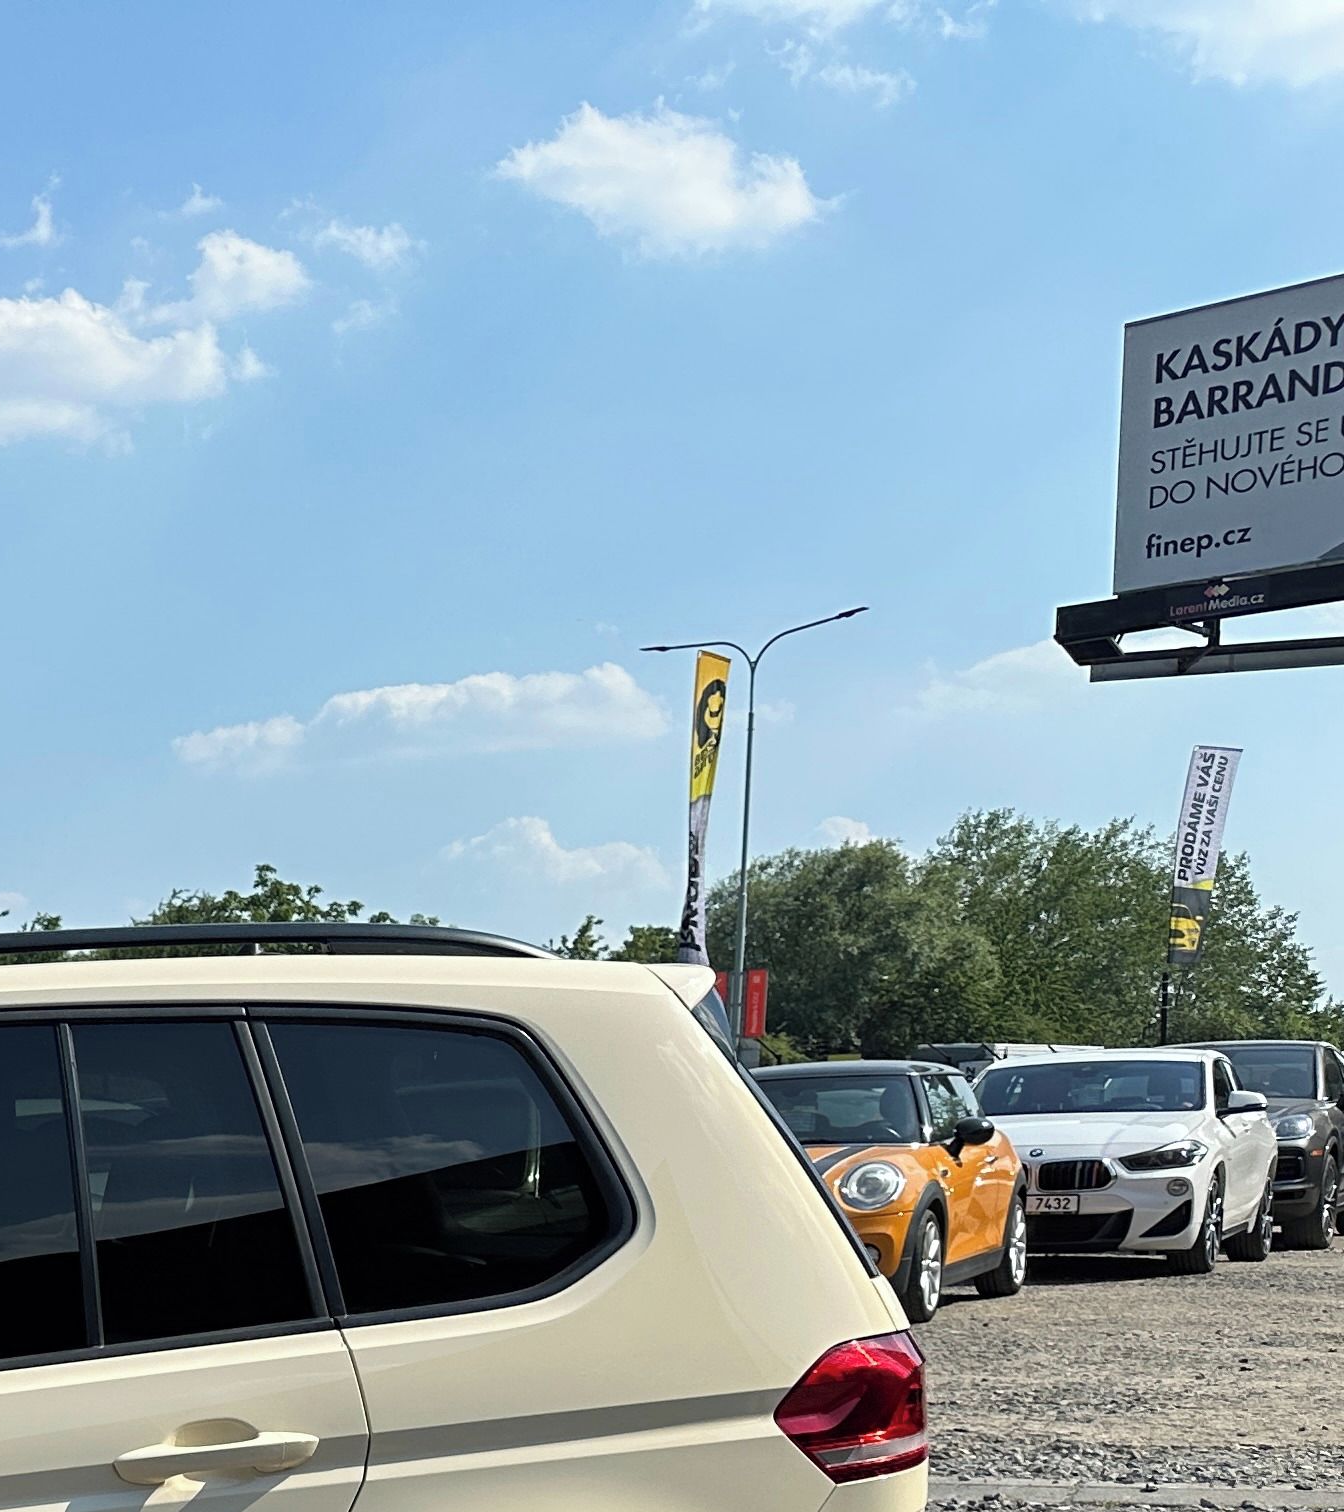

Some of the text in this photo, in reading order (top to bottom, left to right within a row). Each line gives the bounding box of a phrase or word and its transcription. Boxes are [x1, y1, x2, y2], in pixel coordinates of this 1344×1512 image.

[1154, 314, 1344, 384] KASKÁDY
[1150, 426, 1286, 475] STĚHUJTE
[1295, 417, 1330, 448] SE
[1149, 453, 1344, 510] DO NOVÉHO
[1145, 527, 1252, 560] finep.cz
[1212, 755, 1229, 793] CENU
[1177, 752, 1216, 882] PRODÁME VÁŠ
[1035, 1197, 1072, 1211] 7432
